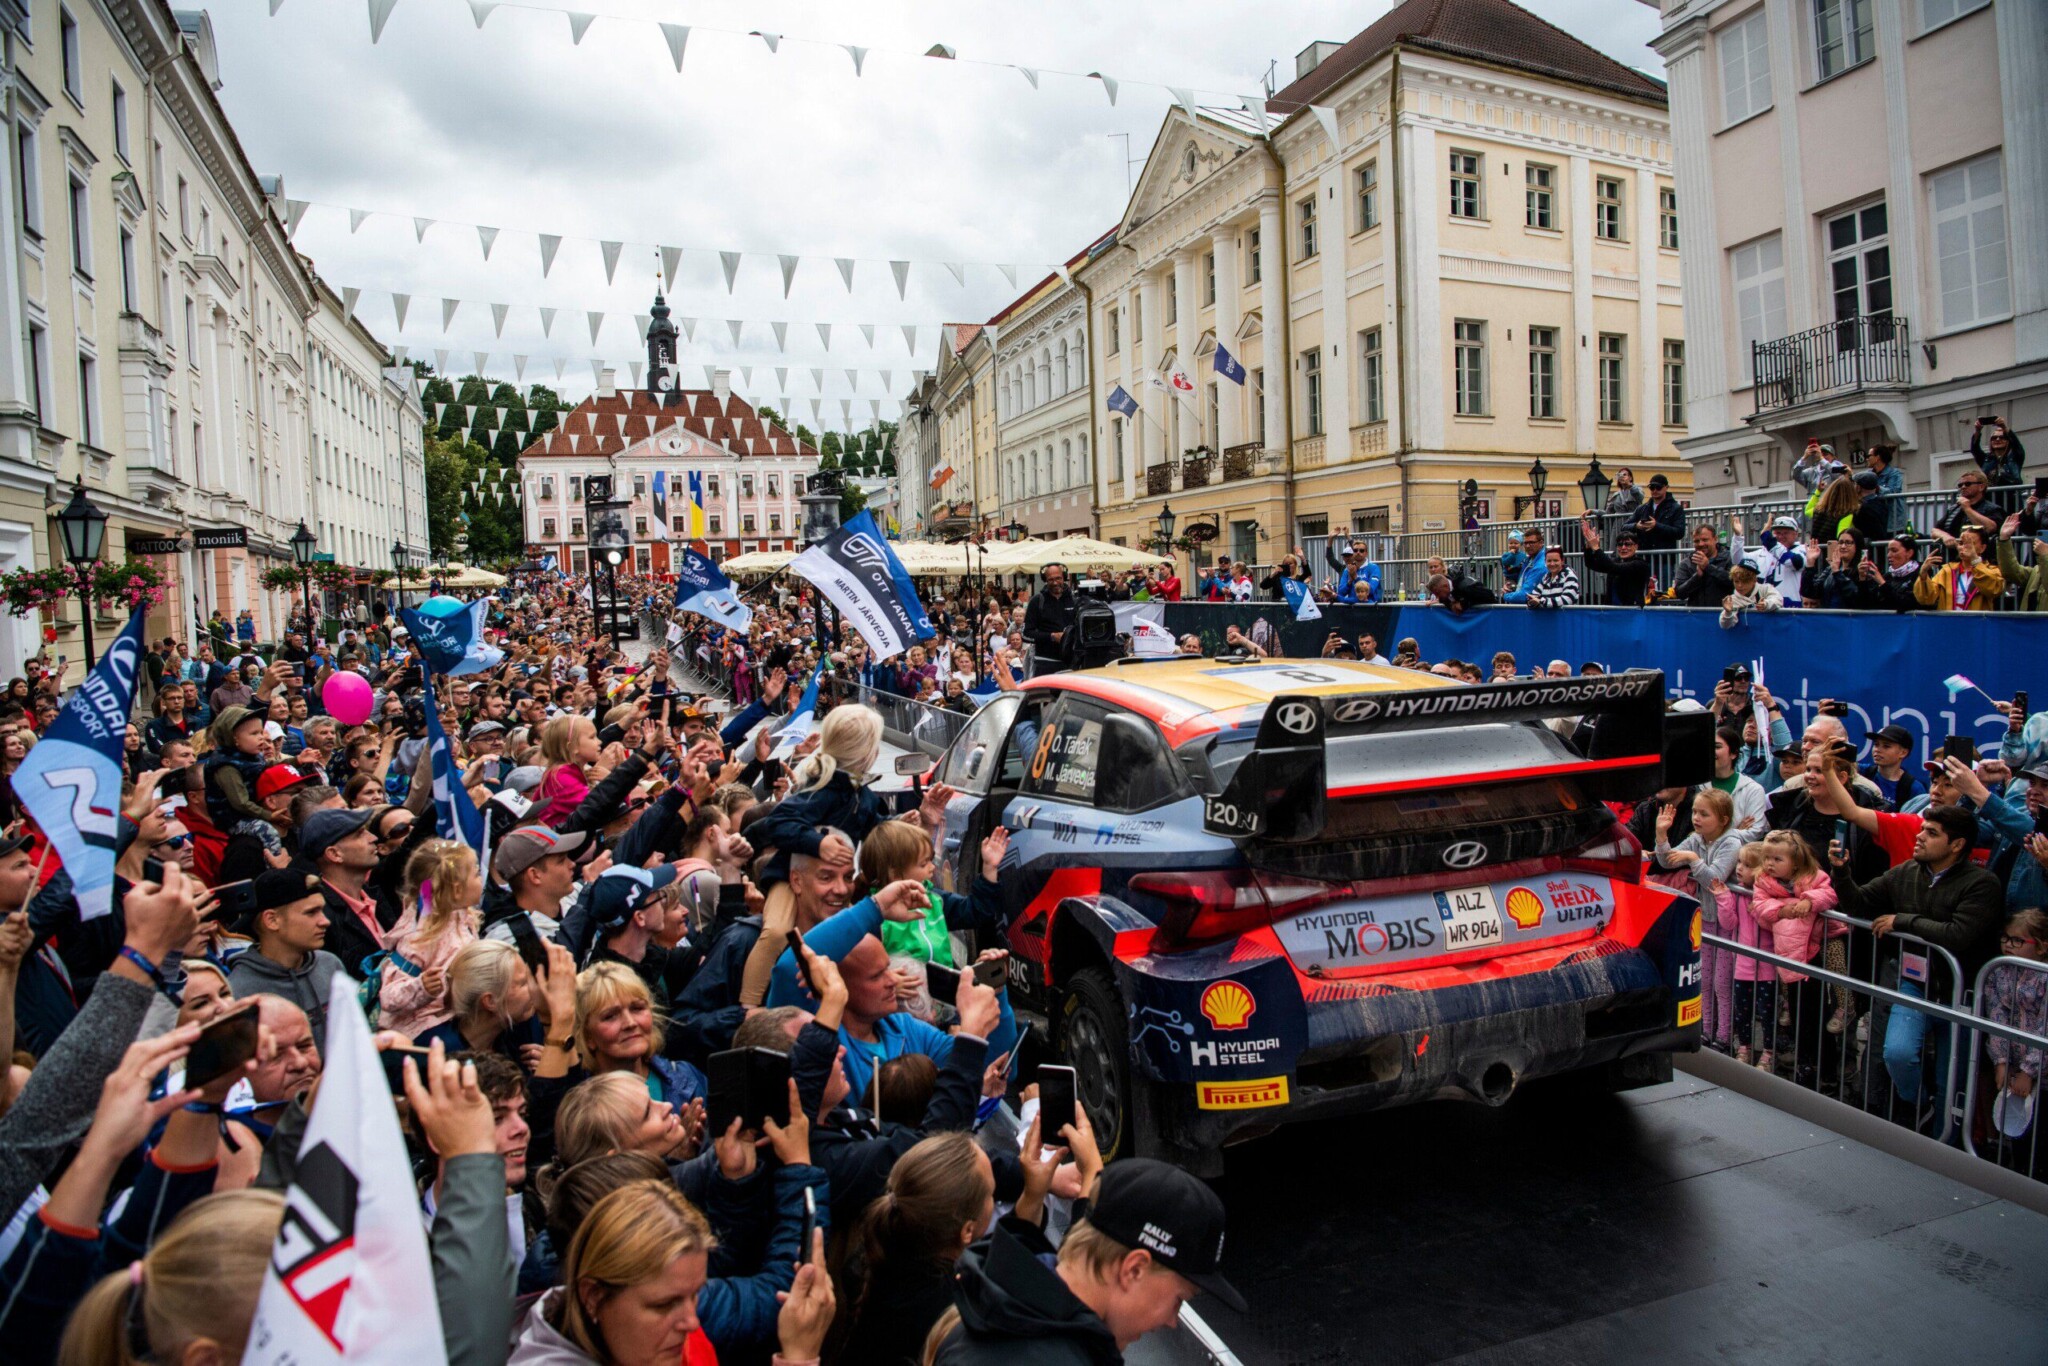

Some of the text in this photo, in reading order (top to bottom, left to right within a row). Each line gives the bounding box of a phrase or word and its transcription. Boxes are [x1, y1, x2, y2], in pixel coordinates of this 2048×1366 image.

[1853, 451, 1865, 464] 18
[135, 540, 175, 552] TATTOO
[199, 532, 243, 545] moniik
[871, 572, 891, 593] OTT
[834, 578, 891, 649] MARTIN JÄRVEOJA
[1384, 692, 1502, 718] HYUNDAI
[1501, 680, 1650, 708] MOTORSPORT
[1032, 723, 1056, 779] 8
[1065, 735, 1093, 756] Tänak
[1117, 821, 1165, 833] HYUNDAI
[1112, 833, 1142, 845] STEEL
[1546, 879, 1570, 892] Shell
[1550, 884, 1603, 908] HELIX
[1443, 908, 1449, 917] D
[1455, 892, 1486, 912] ALZ
[1295, 910, 1376, 931] HYUNDAI
[1557, 904, 1604, 923] ULTRA
[1323, 916, 1436, 960] MOBIS
[1450, 920, 1499, 943] WR 904
[1219, 1038, 1280, 1052] HYUNDAI
[1220, 1053, 1265, 1065] STEEL
[1203, 1083, 1280, 1104] PIRELLI
[1143, 1222, 1172, 1243] RALLY
[1138, 1231, 1178, 1257] FINLAND
